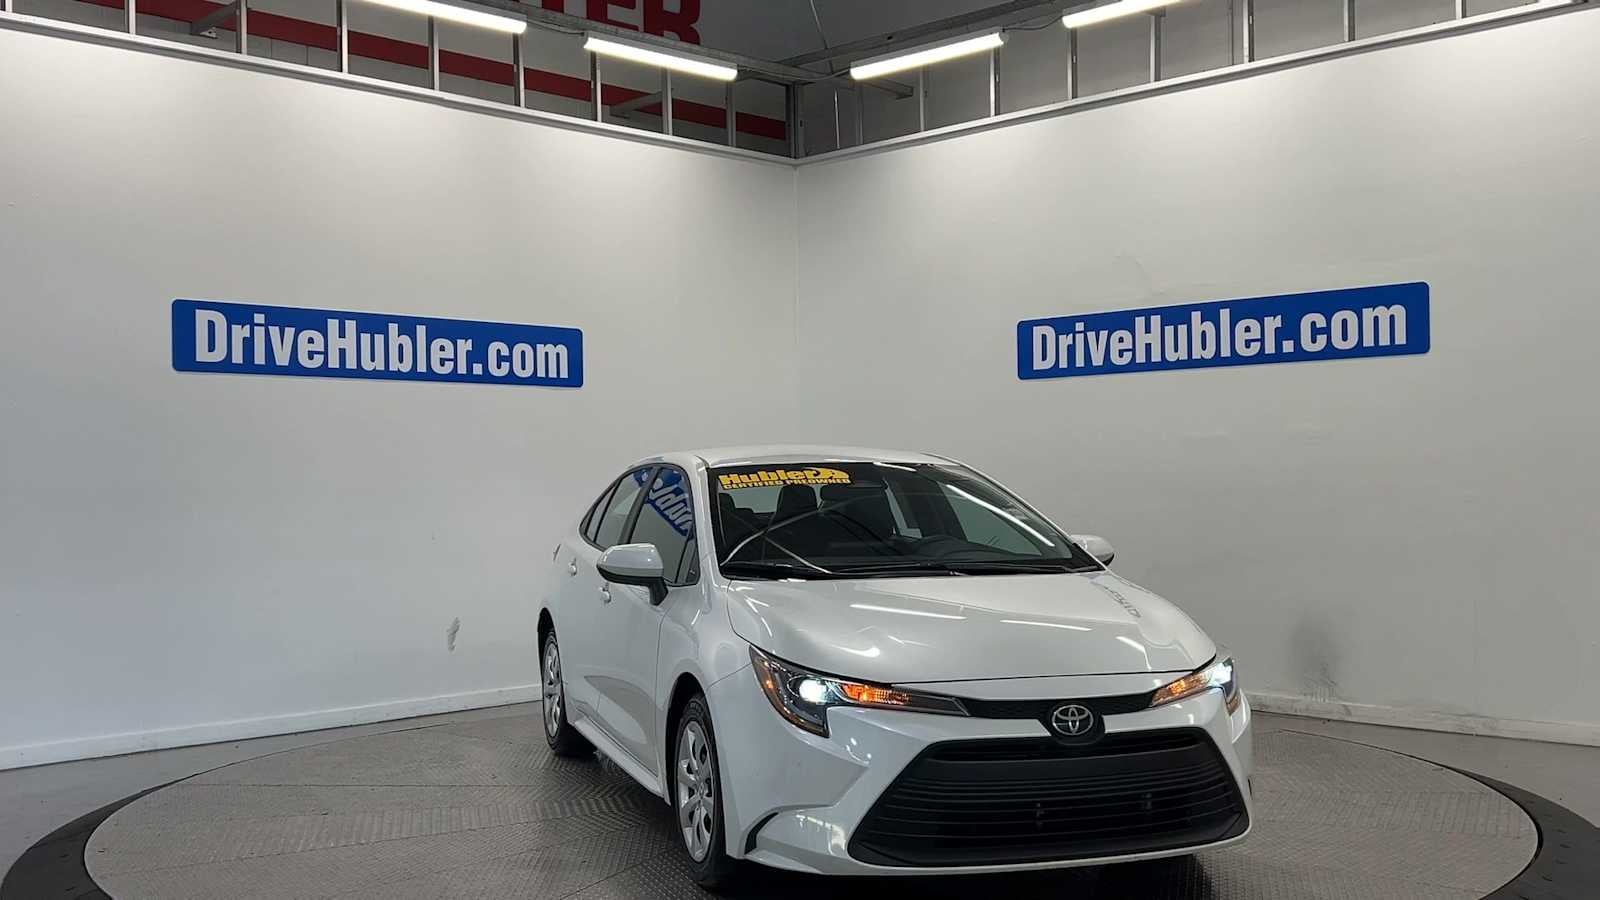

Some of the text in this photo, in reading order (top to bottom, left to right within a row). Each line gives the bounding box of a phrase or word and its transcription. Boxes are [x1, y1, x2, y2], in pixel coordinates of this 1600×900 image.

[195, 309, 569, 379] DriveHubler.com
[1032, 303, 1407, 371] DriveHubler.com
[718, 469, 819, 486] Hubler
[723, 480, 785, 490] CERTIFIED
